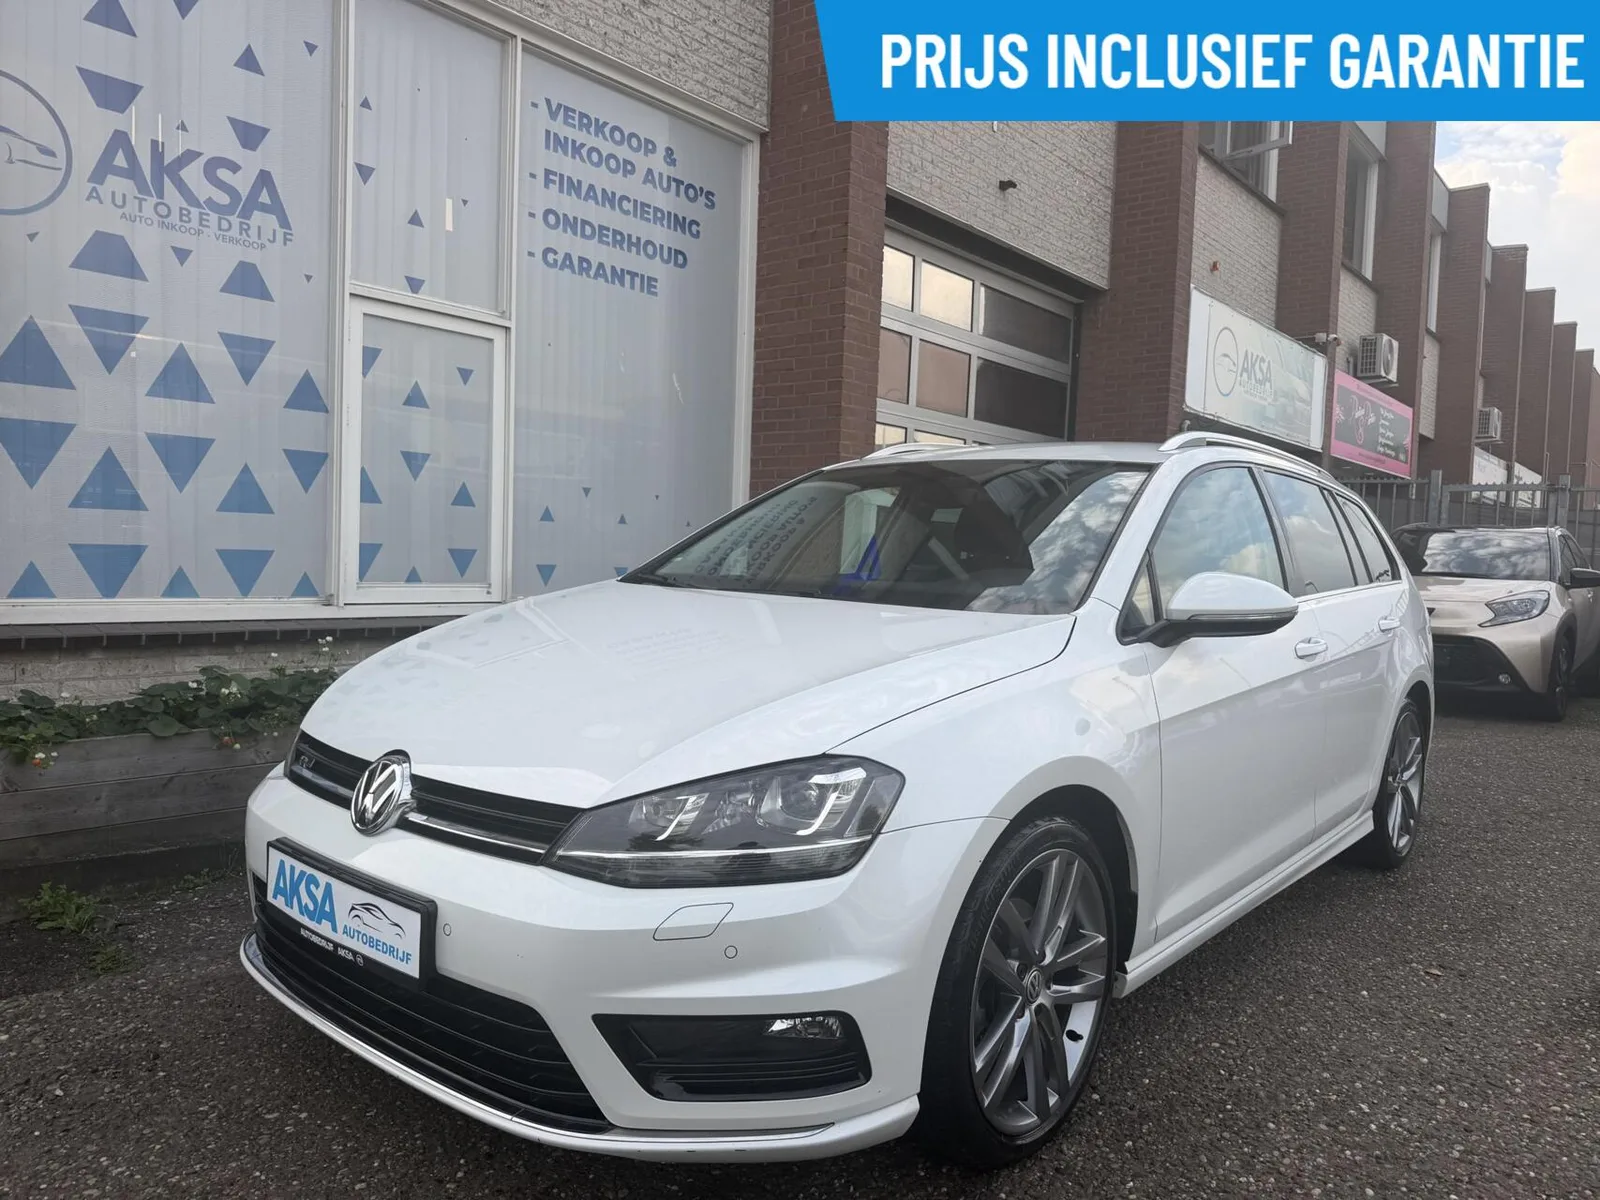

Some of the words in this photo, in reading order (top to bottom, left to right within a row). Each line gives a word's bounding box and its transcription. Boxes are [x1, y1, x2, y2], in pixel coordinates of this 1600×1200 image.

[544, 97, 658, 158] VERKOOP
[663, 146, 677, 168] &
[86, 128, 293, 231] AKSA
[544, 129, 636, 179] INKOOP
[641, 167, 716, 211] AUTO'S
[85, 185, 295, 247] AUTOBEDRIJF
[119, 211, 154, 227] AUTO
[157, 219, 205, 238] INKOOP
[214, 232, 267, 252] VERKOOP
[543, 168, 701, 240] FINANCIERING
[542, 208, 688, 270] ONDERHOUD
[541, 246, 659, 297] GARANTIE
[1240, 349, 1272, 391] AKSA
[272, 859, 338, 934] AKSA
[337, 946, 355, 961] AKSA
[342, 924, 412, 965] AUTOBEDRIJF
